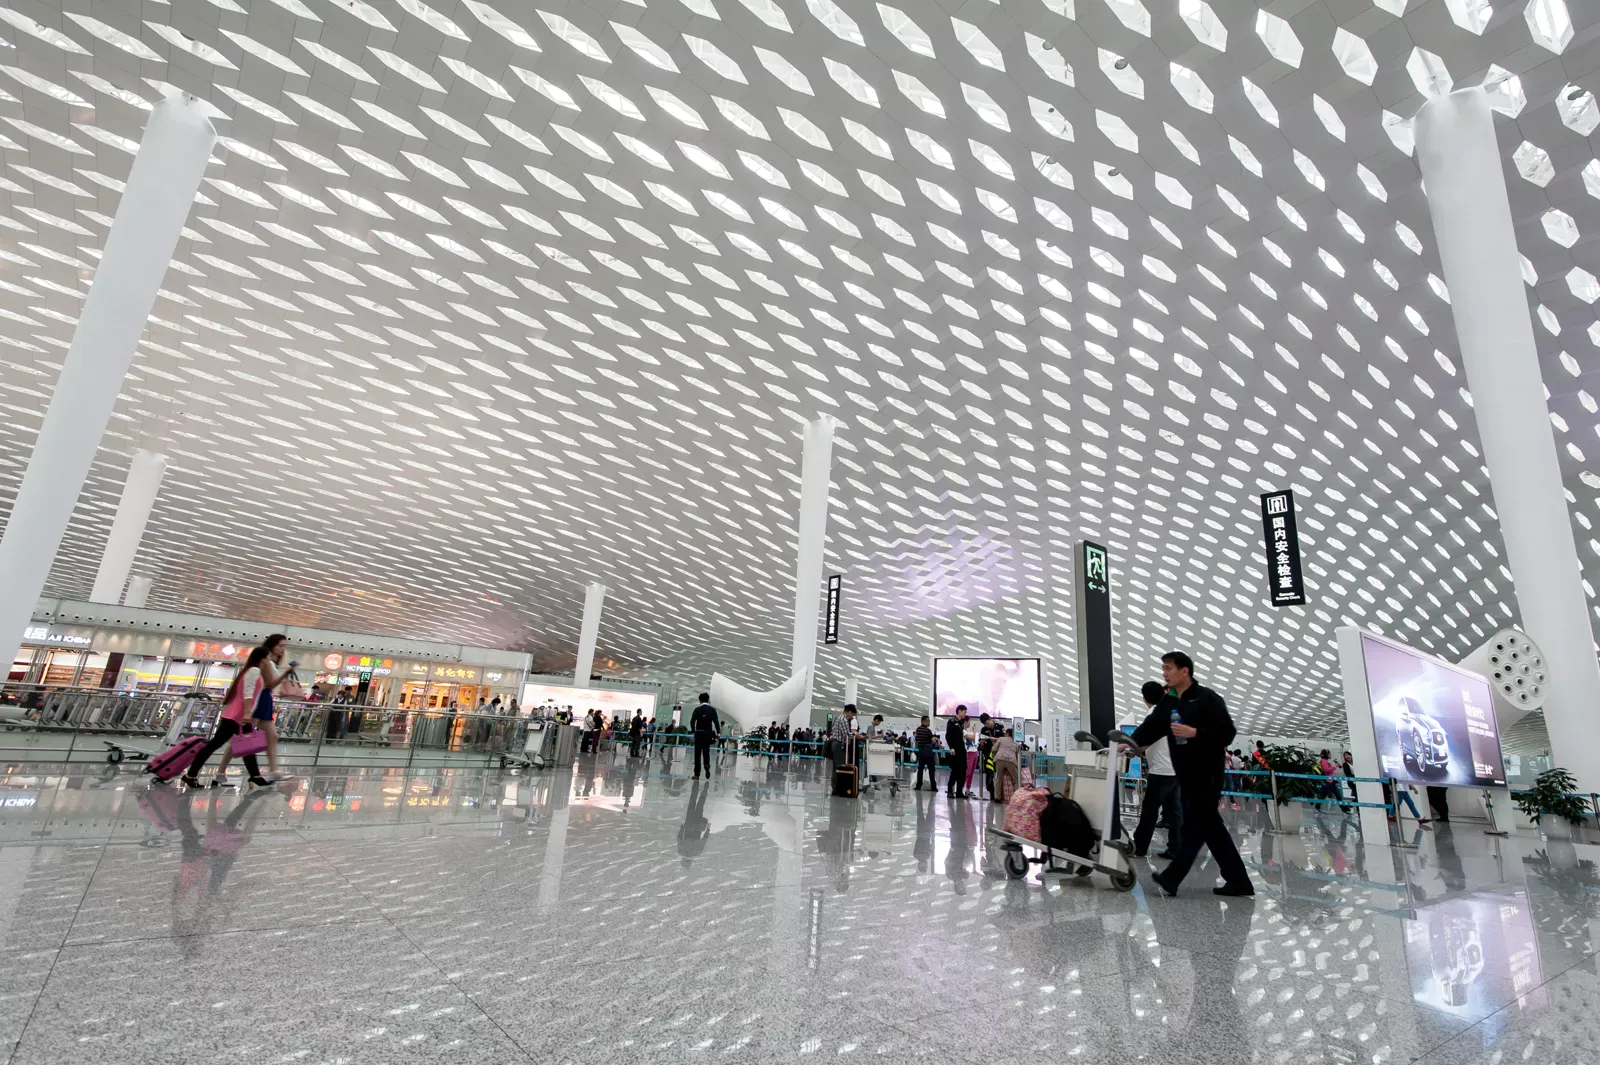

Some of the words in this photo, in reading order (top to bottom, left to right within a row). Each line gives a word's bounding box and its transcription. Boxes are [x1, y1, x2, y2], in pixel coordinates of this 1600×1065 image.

[1272, 517, 1293, 588] 国内安全检查
[47, 634, 62, 642] AJI
